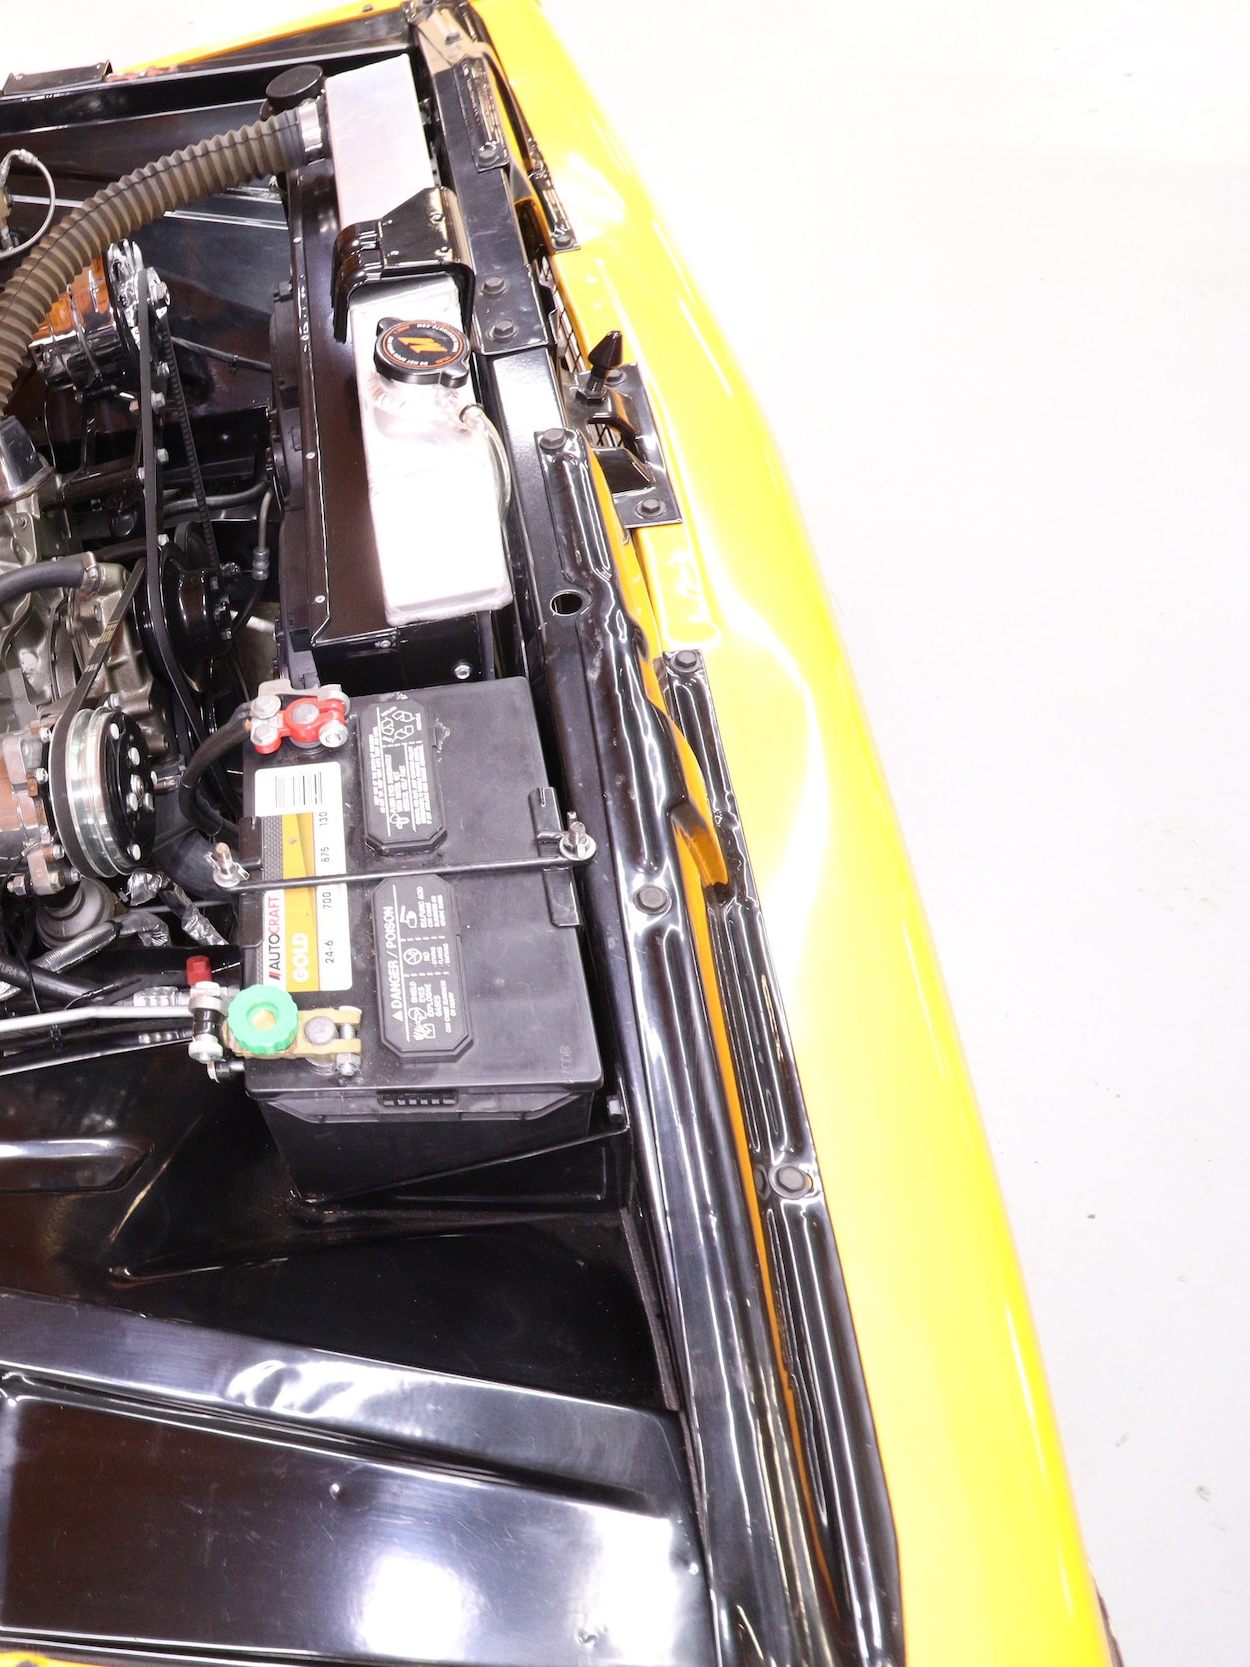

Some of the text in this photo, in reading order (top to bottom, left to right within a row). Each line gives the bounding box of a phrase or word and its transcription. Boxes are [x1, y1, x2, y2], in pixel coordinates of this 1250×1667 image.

[319, 812, 334, 964] 24-6 700 875 130
[267, 896, 281, 971] AUTOCRAFT
[383, 906, 396, 948] POISON
[291, 933, 309, 983] GOLD
[423, 952, 430, 961] NO
[388, 960, 402, 1008] DANGER
[424, 984, 434, 1018] EXPLOSIVE
[434, 995, 442, 1016] GASES
